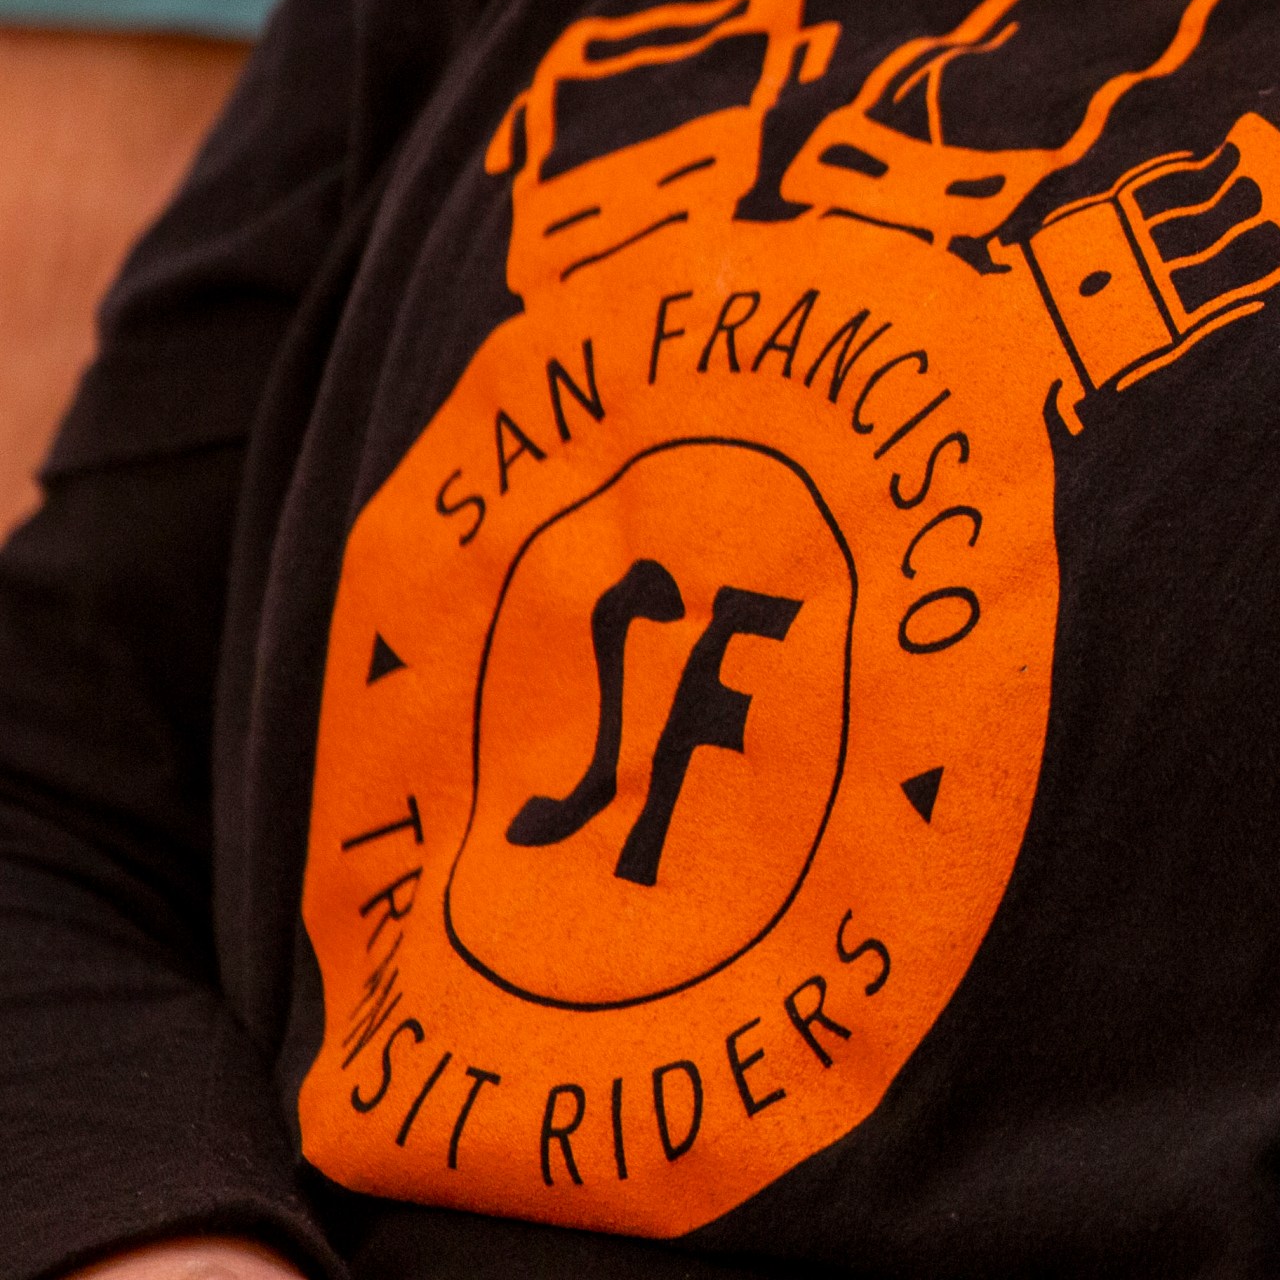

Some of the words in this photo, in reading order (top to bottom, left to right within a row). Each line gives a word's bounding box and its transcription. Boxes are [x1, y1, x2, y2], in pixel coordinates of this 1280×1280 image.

[434, 338, 606, 547] SAN
[647, 287, 983, 655] FRANCISCO
[504, 557, 805, 888] SF
[340, 793, 502, 1172] TRANSIT
[539, 907, 892, 1188] RIDERS
